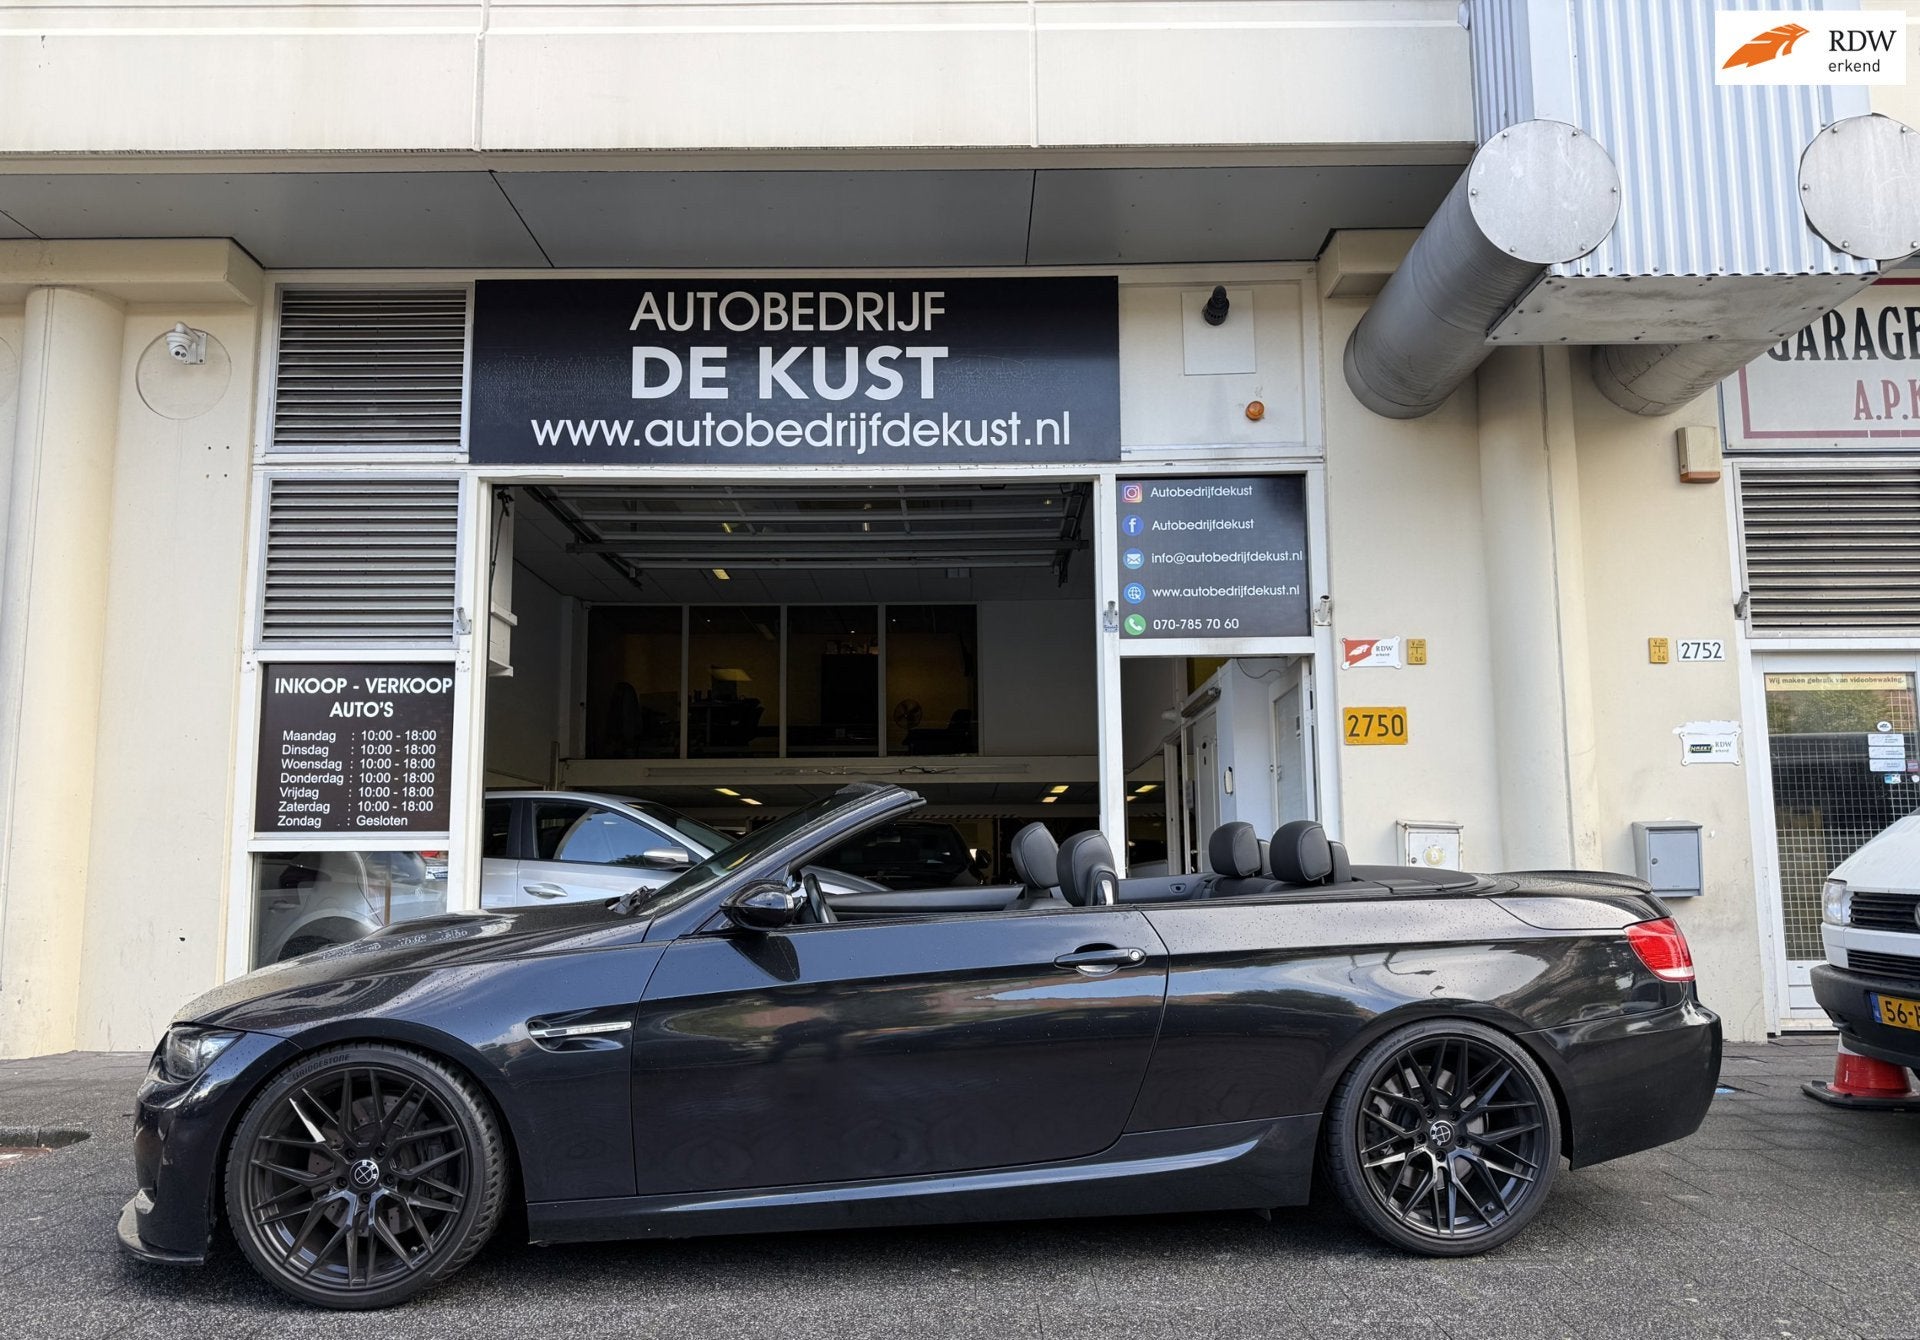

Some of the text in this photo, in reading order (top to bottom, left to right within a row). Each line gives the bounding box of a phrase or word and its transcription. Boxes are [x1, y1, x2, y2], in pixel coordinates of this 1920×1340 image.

[630, 292, 945, 331] AUTOBEDRIJF
[632, 346, 948, 400] DE KUST
[531, 411, 1069, 454] www.autobedrijfdekust.nl
[1151, 486, 1252, 498] Autobedrijfdekust
[1152, 519, 1254, 531] Autobedrijfdekust
[1152, 551, 1302, 564] info@autobedrijfdekust.nl
[1152, 585, 1299, 598] www.autobedrijfdekust.nl
[1154, 619, 1239, 629] 070-785 70 60
[1682, 642, 1722, 659] 2752
[275, 678, 347, 693] INKOOP
[365, 678, 452, 693] VERKOOP
[1348, 714, 1403, 737] 2750
[283, 730, 336, 743] Maandag
[362, 730, 393, 740] 10:00
[405, 730, 436, 740] 18:00
[282, 745, 328, 757] Dinsdag
[361, 744, 392, 754] 10:00
[405, 744, 435, 754] 18:00
[282, 759, 342, 771] Woensdag
[360, 758, 391, 769] 10:00
[404, 758, 435, 769] 18:00
[281, 773, 343, 785] Donderdag
[360, 773, 391, 783] 10:00
[403, 772, 434, 783] 18:00
[280, 787, 319, 800] Vrijdag
[359, 787, 390, 797] 10:00
[403, 787, 434, 797] 18:00
[278, 801, 330, 814] Zaterdag
[358, 801, 389, 811] 10:00
[402, 801, 433, 811] 18:00
[278, 816, 321, 828] Zondag
[357, 815, 407, 826] Gesloten
